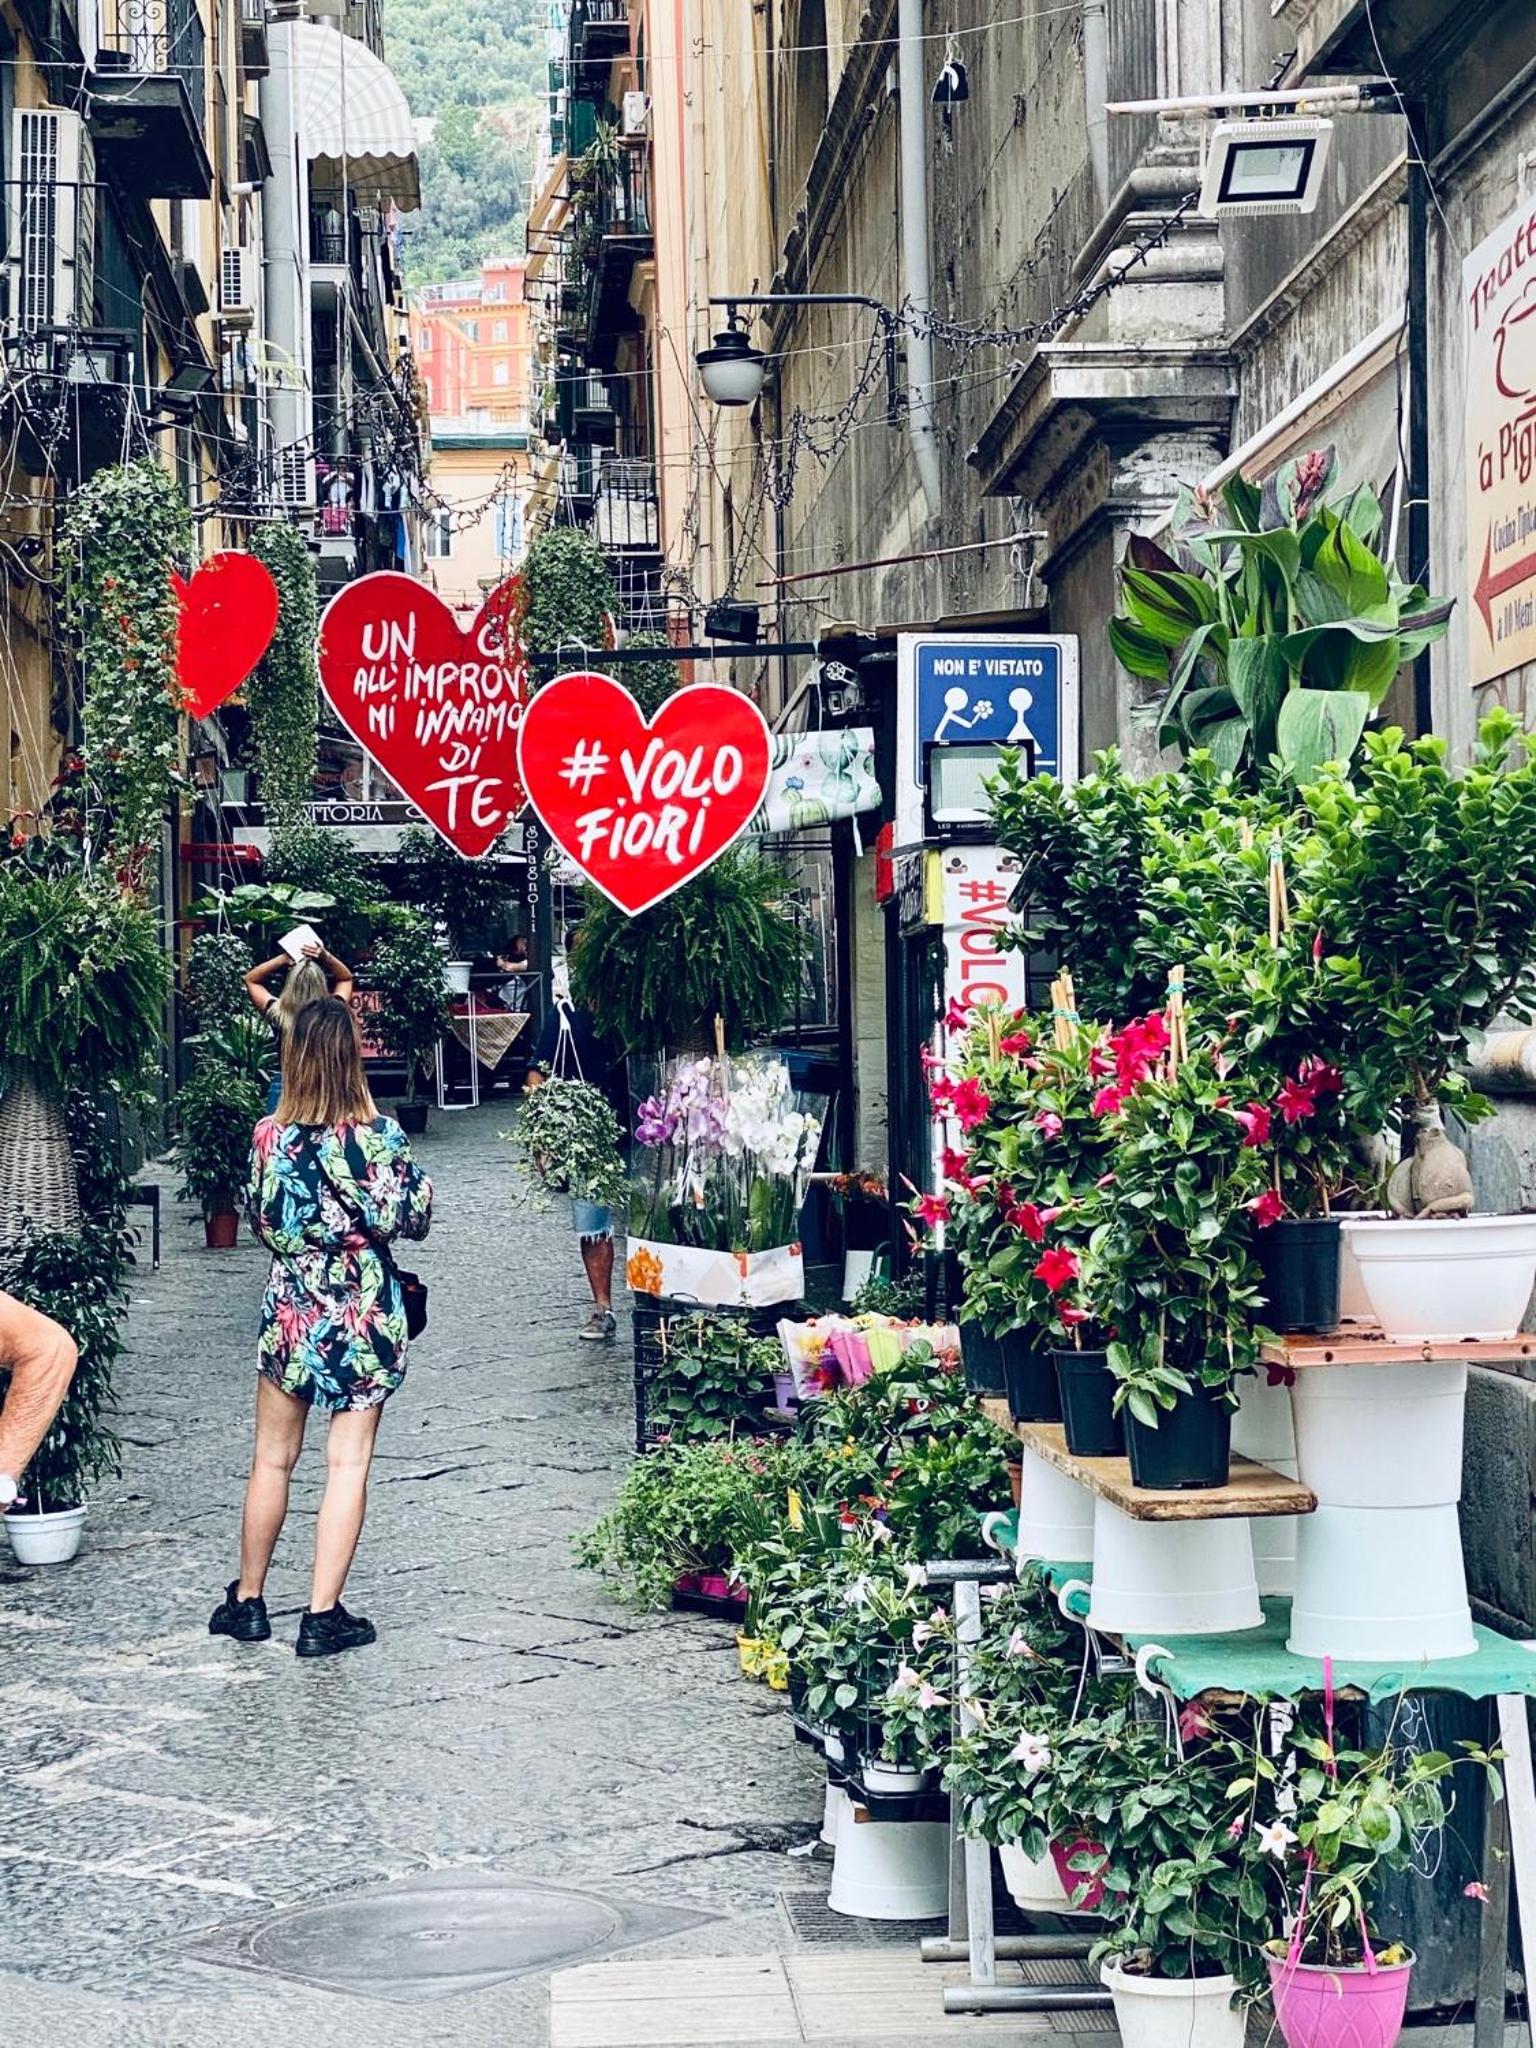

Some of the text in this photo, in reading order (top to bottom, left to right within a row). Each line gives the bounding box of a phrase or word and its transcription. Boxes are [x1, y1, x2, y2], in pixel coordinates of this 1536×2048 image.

[1499, 422, 1536, 484] Pig
[1493, 515, 1516, 553] Cucina
[362, 611, 415, 661] UN
[934, 659, 1043, 676] NON E' VIETATO
[439, 736, 488, 772] DI
